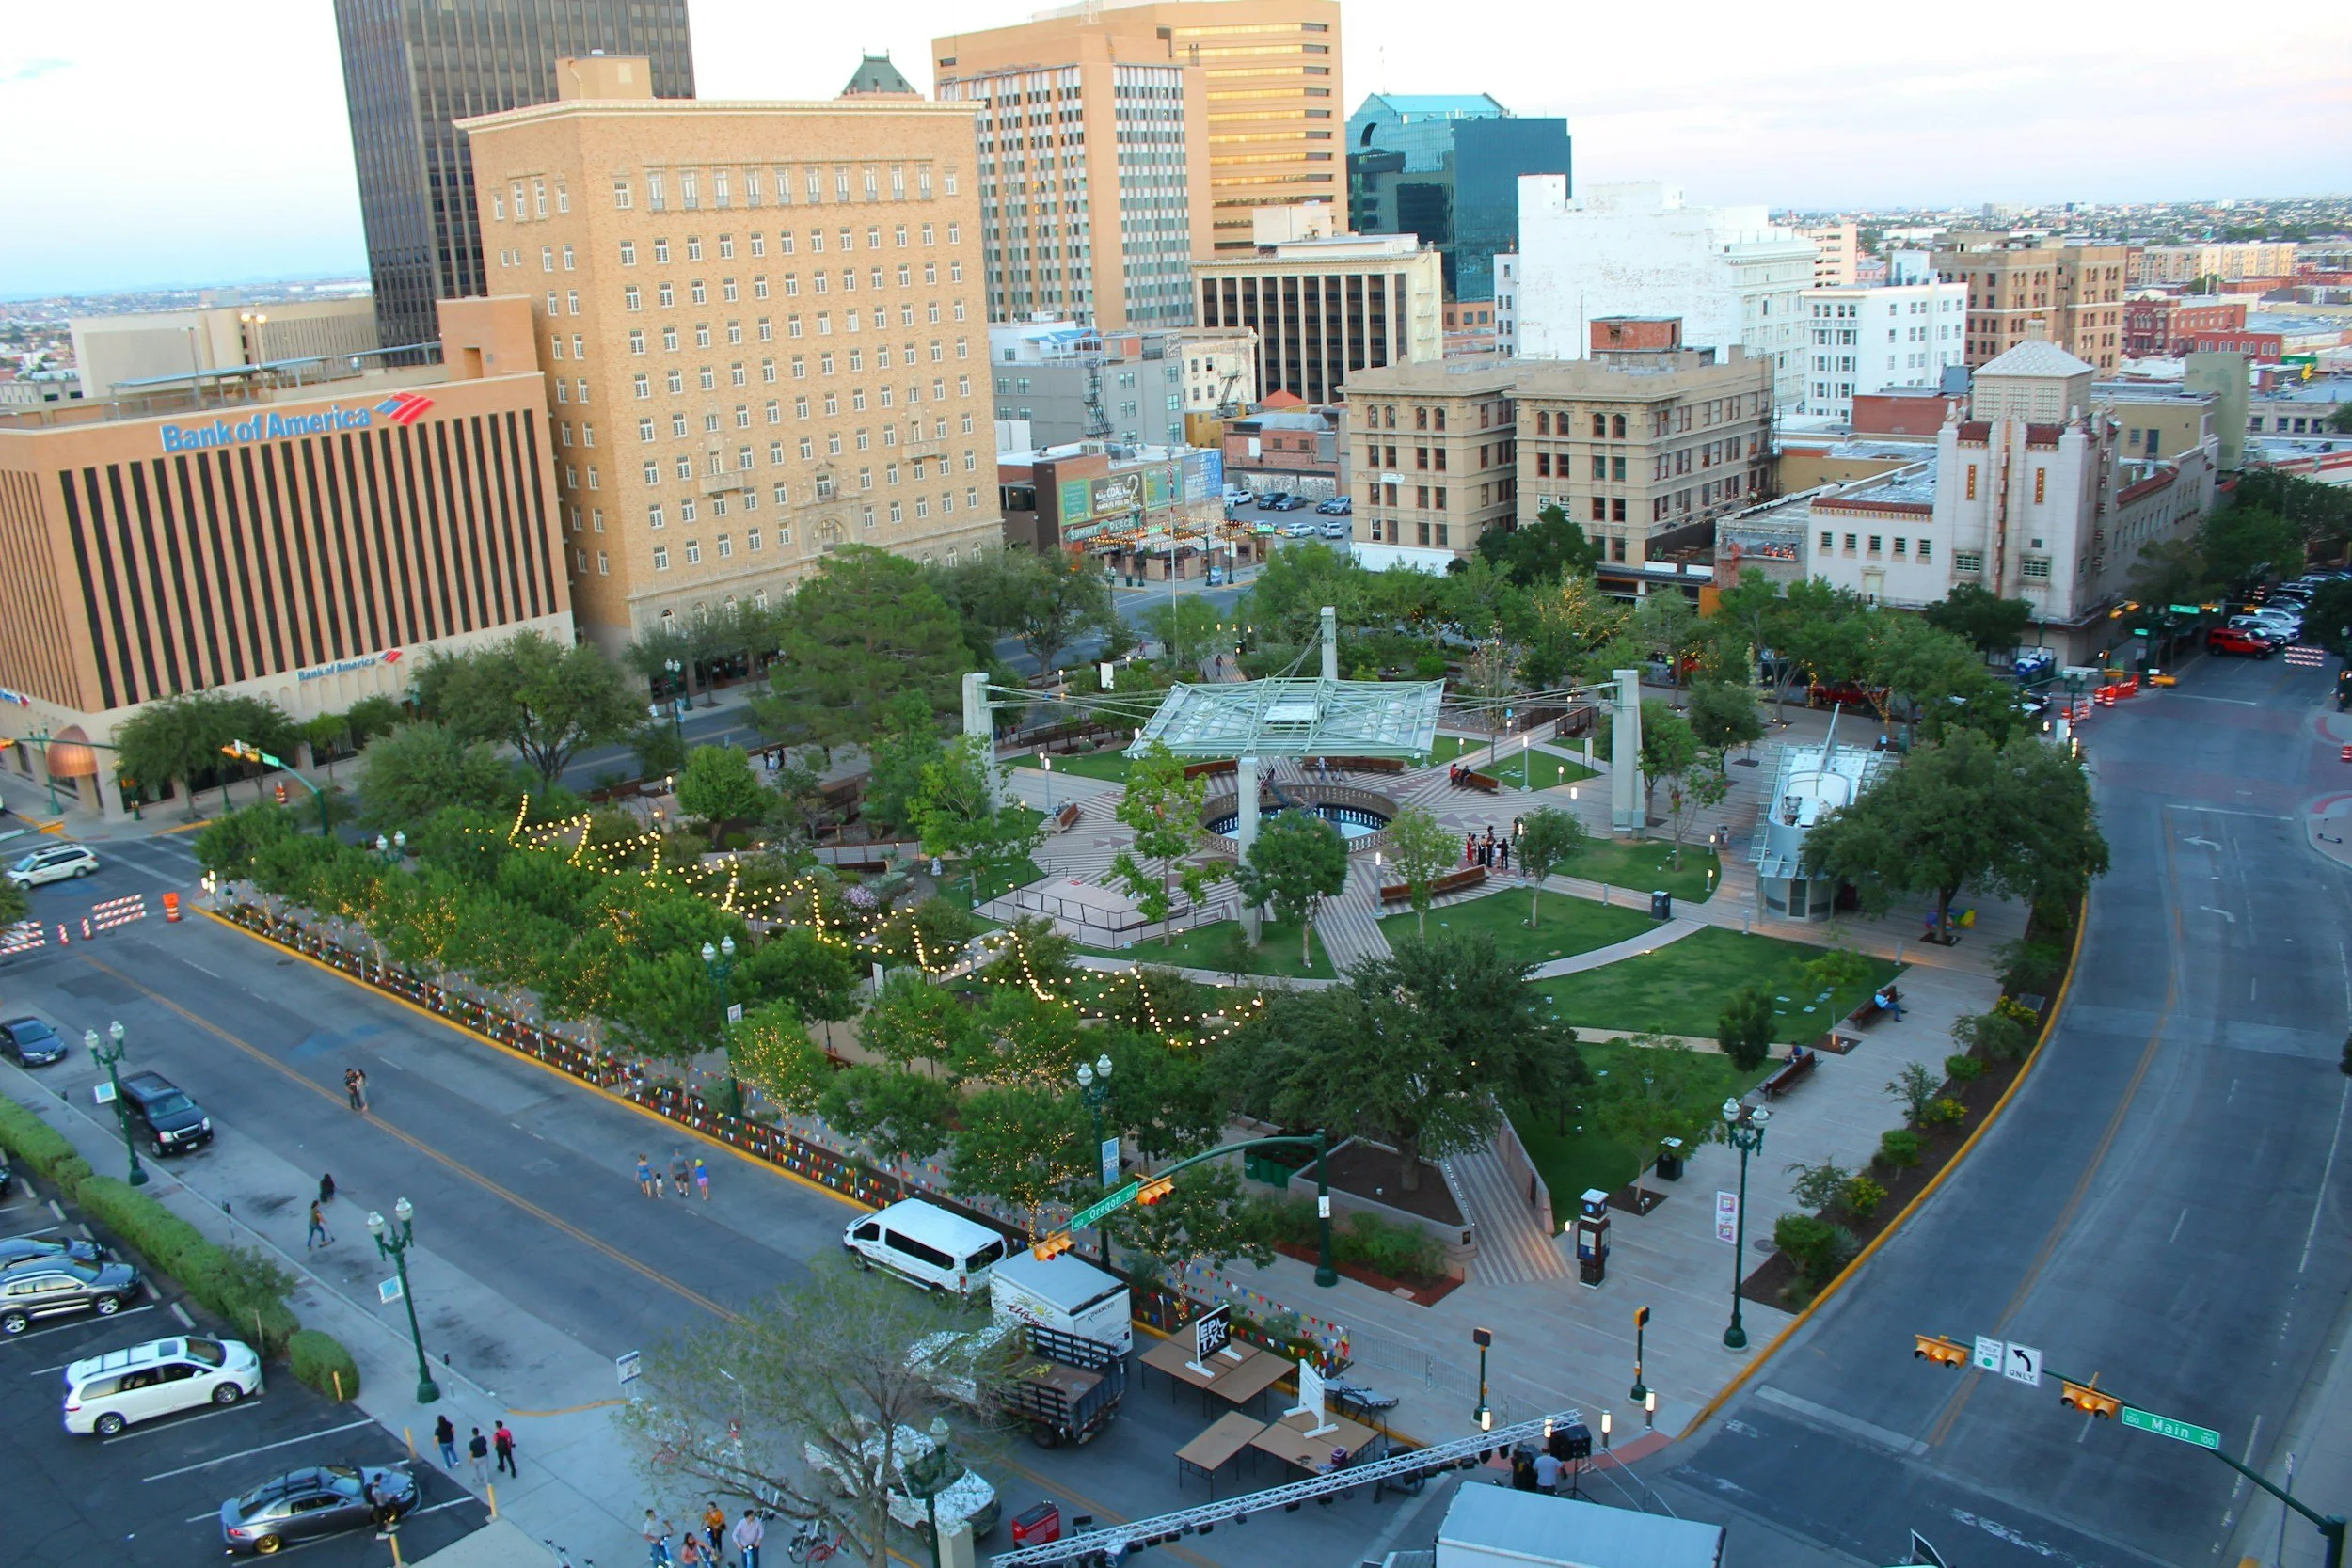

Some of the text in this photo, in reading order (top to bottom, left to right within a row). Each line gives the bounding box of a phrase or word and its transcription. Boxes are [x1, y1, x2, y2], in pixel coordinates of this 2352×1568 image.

[160, 404, 371, 452] Bank of America
[1106, 485, 1123, 498] COAL
[1070, 517, 1134, 540] SUMMIT PLACE
[297, 657, 376, 681] Bank of America
[1089, 1196, 1121, 1219] Oregon
[1087, 1302, 1115, 1324] ADVANCED
[1200, 1331, 1219, 1351] TX
[2009, 1369, 2033, 1381] ONLY
[2126, 1415, 2215, 1446] 100 Main 100
